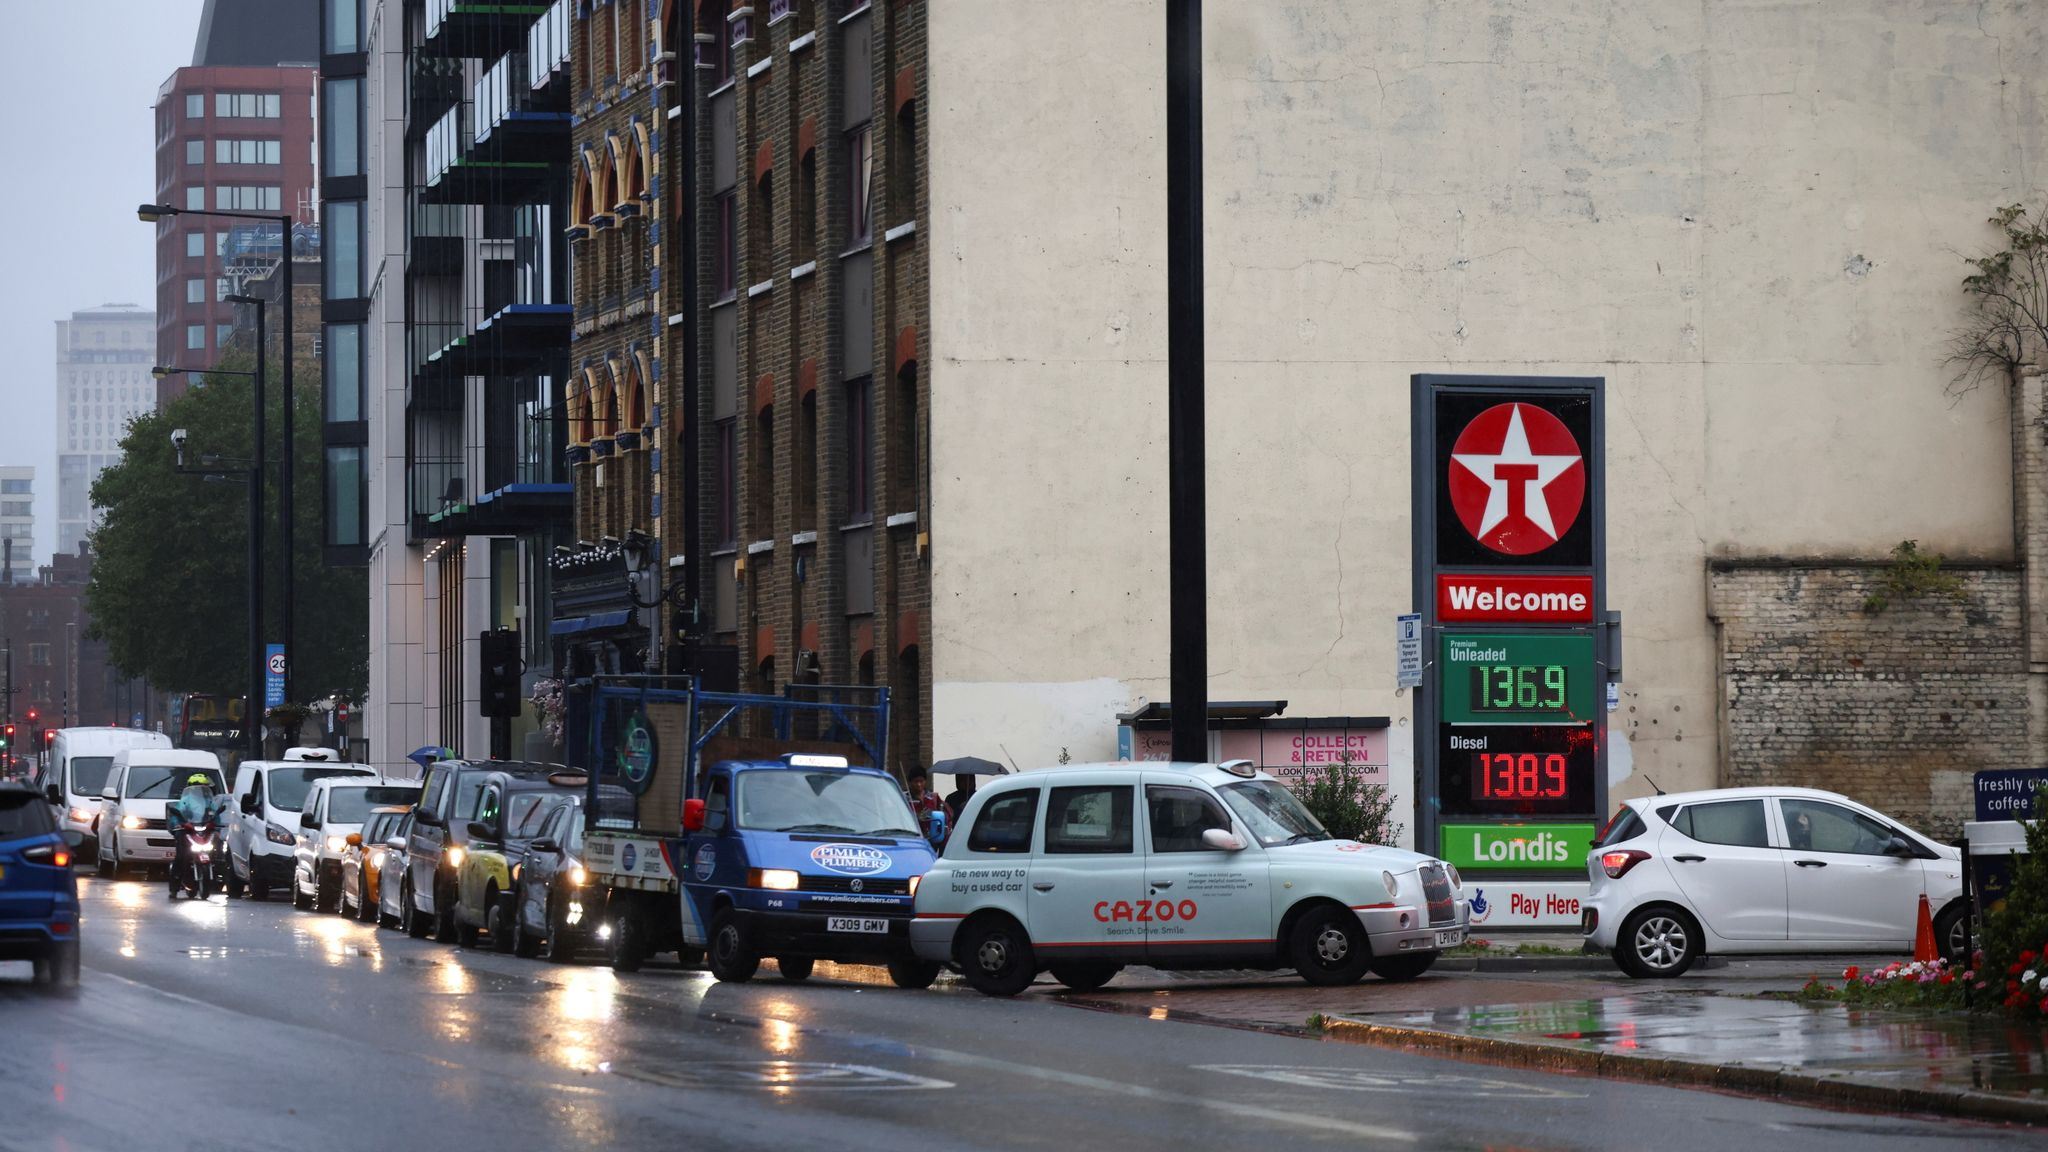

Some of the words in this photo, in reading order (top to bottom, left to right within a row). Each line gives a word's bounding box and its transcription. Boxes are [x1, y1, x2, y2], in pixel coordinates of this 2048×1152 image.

[1449, 586, 1586, 611] Welcome
[1450, 647, 1506, 661] Unleaded
[1480, 665, 1565, 708] 136.9
[229, 730, 240, 738] 77
[1292, 736, 1367, 748] COLLECT
[1450, 736, 1488, 749] Diesel
[1291, 751, 1302, 762] &
[1305, 750, 1368, 762] RETURN
[1480, 754, 1566, 797] 138.9
[1979, 778, 2023, 793] freshly
[1988, 796, 2028, 810] coffee
[1474, 832, 1569, 862] Londis
[821, 848, 883, 860] PIMLICO
[822, 858, 886, 868] PLUMBERS
[952, 870, 967, 878] The
[992, 870, 1012, 880] way
[1014, 869, 1026, 878] to
[952, 883, 968, 894] buy
[980, 882, 1004, 892] used
[1005, 884, 1022, 892] car
[812, 894, 900, 904] www.pimlicoplumbers.com
[1093, 899, 1198, 922] CAZOO
[1511, 894, 1540, 918] Play
[1546, 894, 1580, 914] Here
[832, 919, 861, 930] X309
[864, 920, 886, 932] GMV
